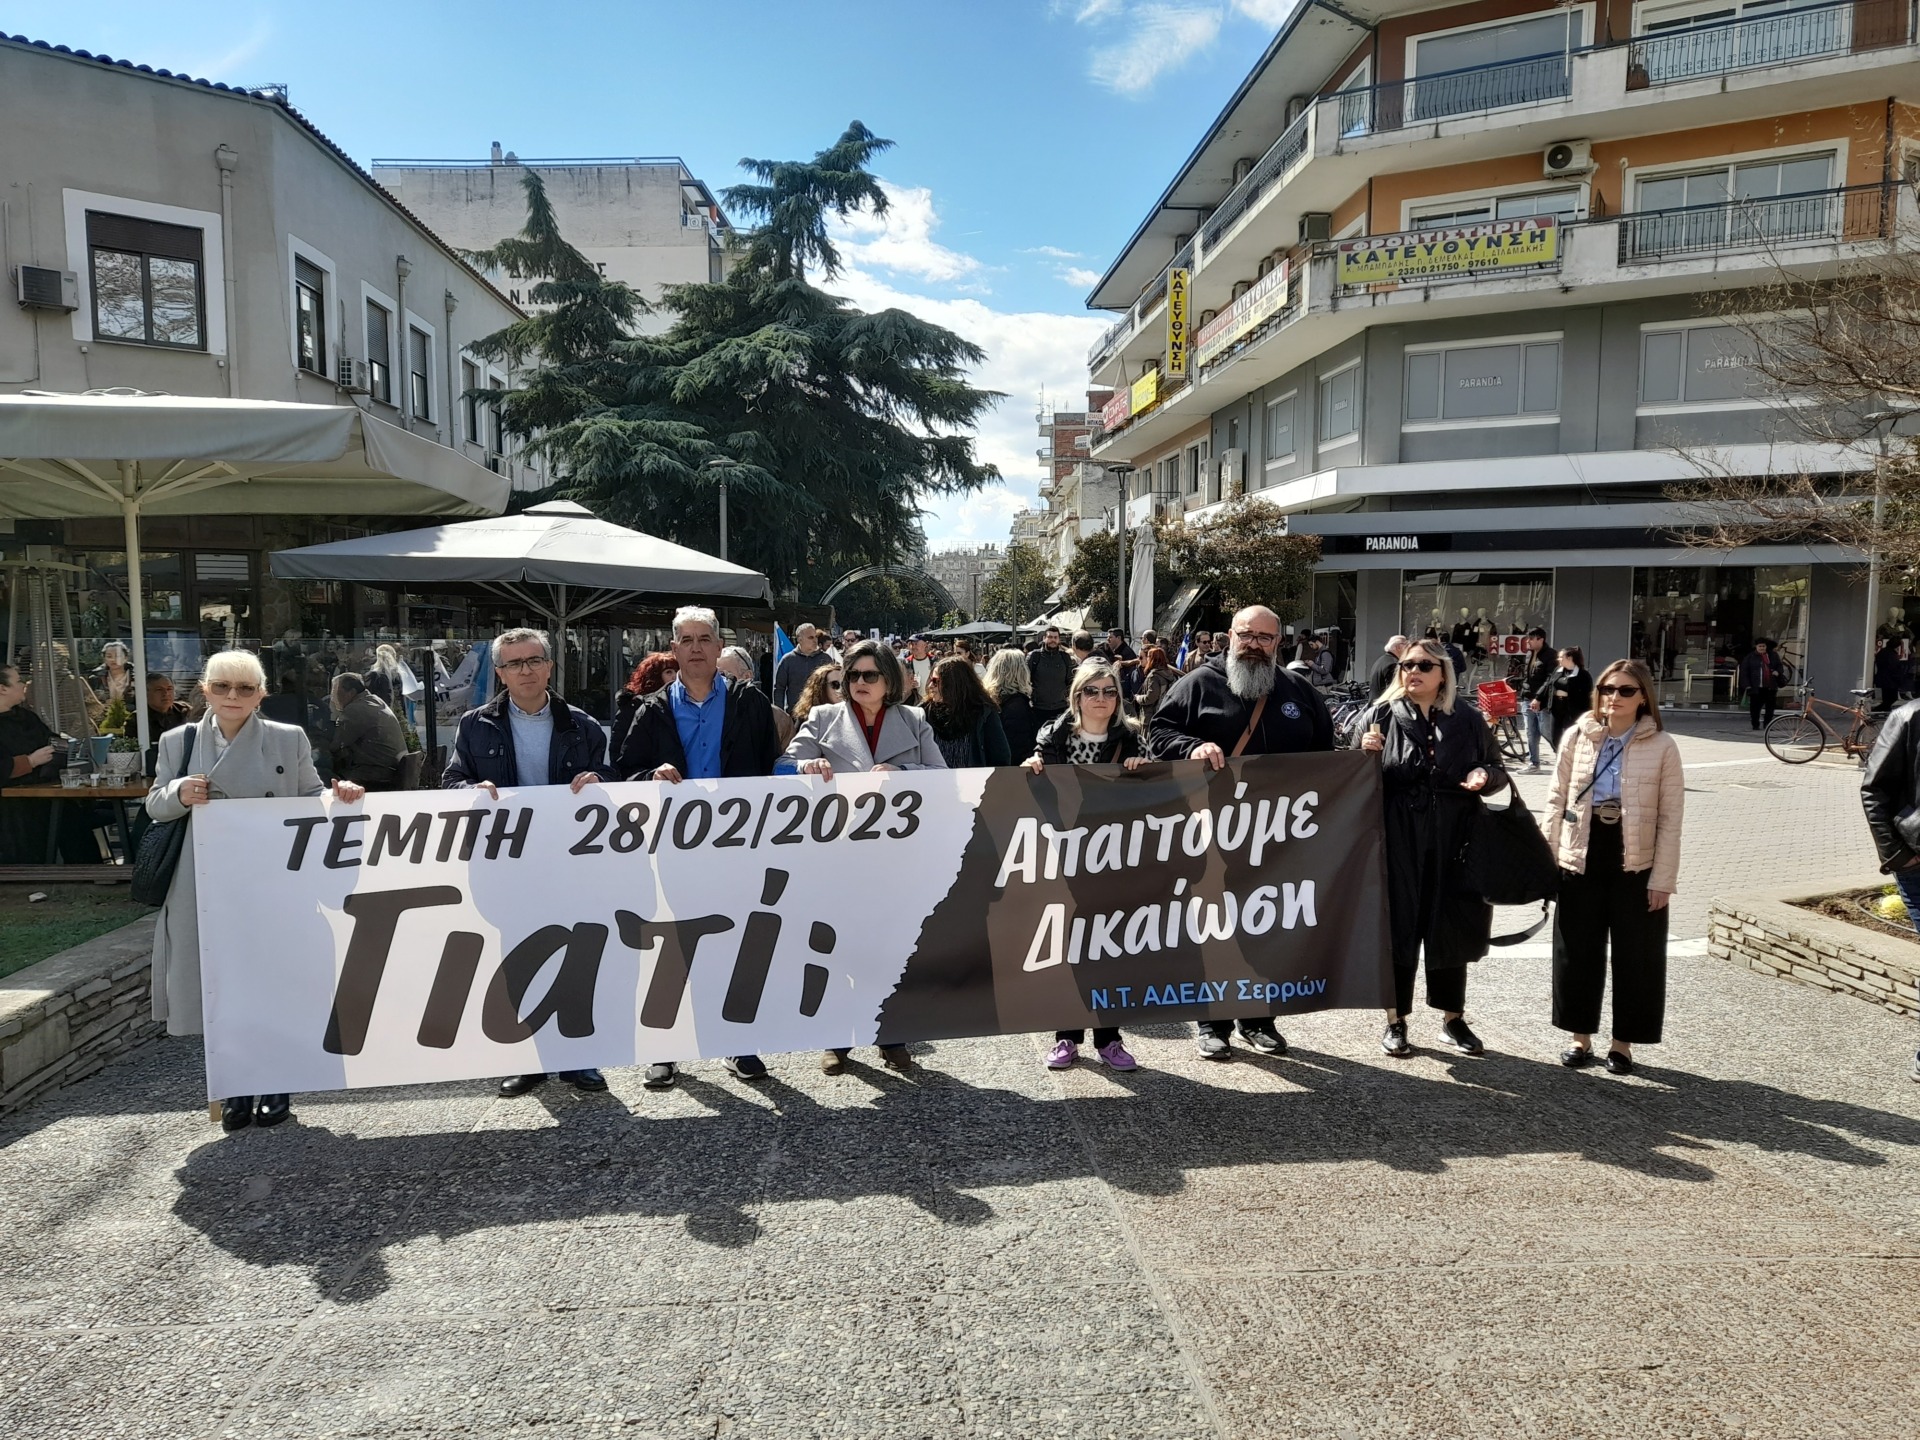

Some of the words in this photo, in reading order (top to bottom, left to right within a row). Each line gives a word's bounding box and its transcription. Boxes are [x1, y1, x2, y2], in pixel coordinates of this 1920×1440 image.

[1346, 229, 1546, 266] ΚΑΤΕΥΘΥΝΣΗ
[1352, 219, 1540, 251] ΦΡΟΝΤΙΣΤΗΡΙΑ
[1398, 266, 1427, 276] 23210
[1429, 262, 1459, 273] 21750
[1468, 257, 1499, 268] 97610
[1171, 270, 1184, 370] ΚΑΤΕΥΘΥΝΣΗ
[283, 807, 534, 871] ΤΕΜΠΗ
[568, 789, 923, 856] 28/02/2023
[994, 781, 1320, 888] Απαιτούμε
[1022, 877, 1318, 973] Δικαίωση
[1143, 982, 1228, 1007] ΑΔΕΔΥ
[1237, 976, 1327, 1006] Σερρών
